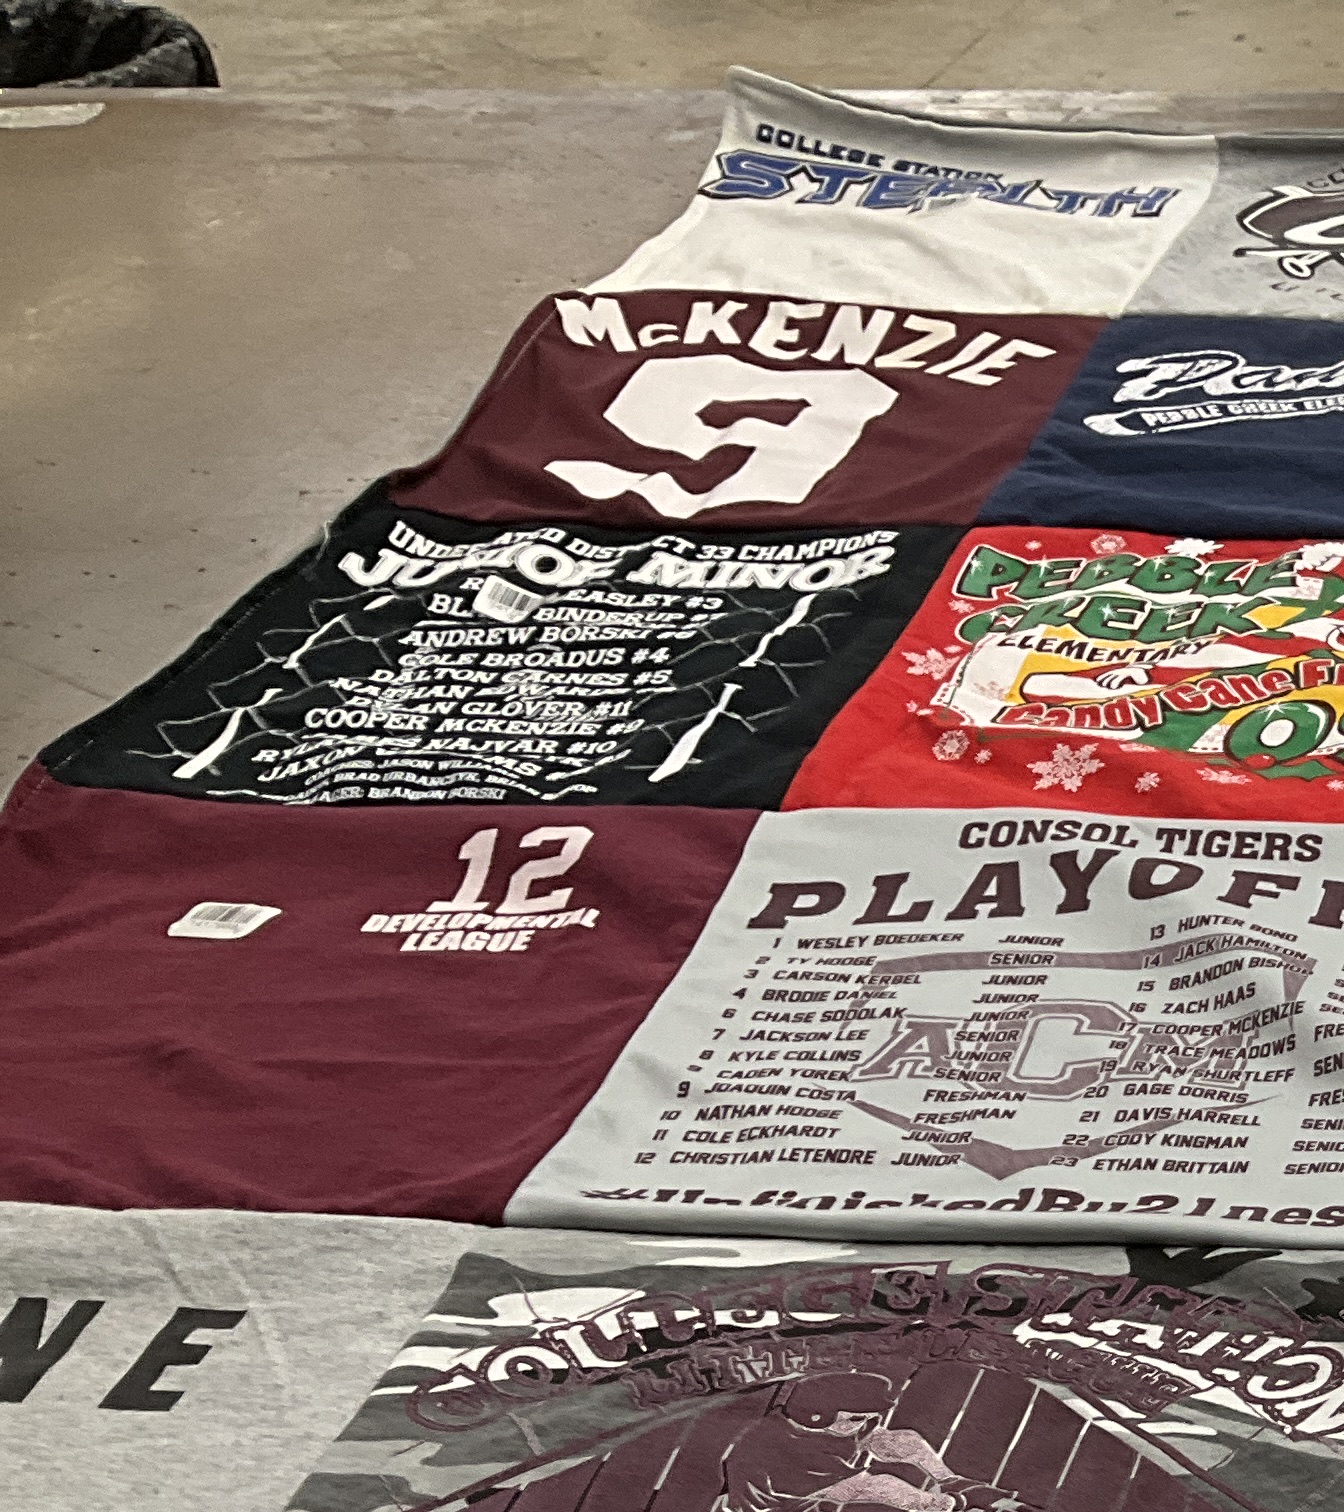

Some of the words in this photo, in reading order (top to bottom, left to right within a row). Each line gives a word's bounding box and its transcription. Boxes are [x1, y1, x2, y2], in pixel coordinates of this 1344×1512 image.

[755, 122, 883, 168] COLLEGE
[893, 158, 1003, 181] STATION
[1143, 403, 1221, 429] PEBBLE
[542, 354, 900, 520] 9
[696, 545, 729, 560] 33
[737, 530, 899, 561] CHAMPIONS
[626, 546, 895, 592] MINOR
[952, 544, 1302, 601] PEBBLE
[685, 597, 722, 610] #3
[955, 594, 1281, 644] CREEK
[398, 626, 537, 648] ANDREW
[537, 624, 656, 643] BORSKI
[398, 652, 482, 667] COLE
[479, 648, 627, 669] BROADUS
[631, 647, 671, 663] #4
[996, 635, 1216, 664] ELEMENTARY
[368, 669, 499, 685] DALTON
[501, 669, 629, 686] CARNES
[633, 669, 672, 683] #5
[461, 701, 586, 717] GLOVER
[594, 701, 633, 717] #11
[992, 694, 1163, 730] Candy
[1159, 668, 1295, 714] Cane
[304, 707, 430, 730] COOPER
[434, 718, 602, 735] MCKENZIE
[567, 741, 618, 754] #10
[957, 818, 1139, 849] CONSOL
[1156, 828, 1324, 863] TIGERS
[425, 826, 594, 914] 12
[360, 908, 600, 933] DEVELOPMENTAL
[400, 930, 535, 952] LEAGUE
[797, 936, 869, 950] WESLEY
[999, 934, 1066, 947] JUNIOR
[739, 1029, 832, 1042] JACKSON
[836, 1029, 870, 1042] LEE
[1079, 1111, 1100, 1123] 21
[1114, 1107, 1175, 1124] DAVIS
[1176, 1108, 1261, 1127] HARRELL
[1062, 1134, 1089, 1146] 22
[1103, 1134, 1158, 1148] CODY
[1160, 1134, 1250, 1149] KINGMAN
[634, 1152, 656, 1165] 12
[669, 1150, 773, 1166] CHRISTIAN
[777, 1149, 876, 1165] LETENDRE
[891, 1153, 965, 1168] JUNIOR
[1050, 1155, 1079, 1168] 23
[1092, 1157, 1159, 1172] ETHAN
[1162, 1159, 1250, 1175] BRITTAIN
